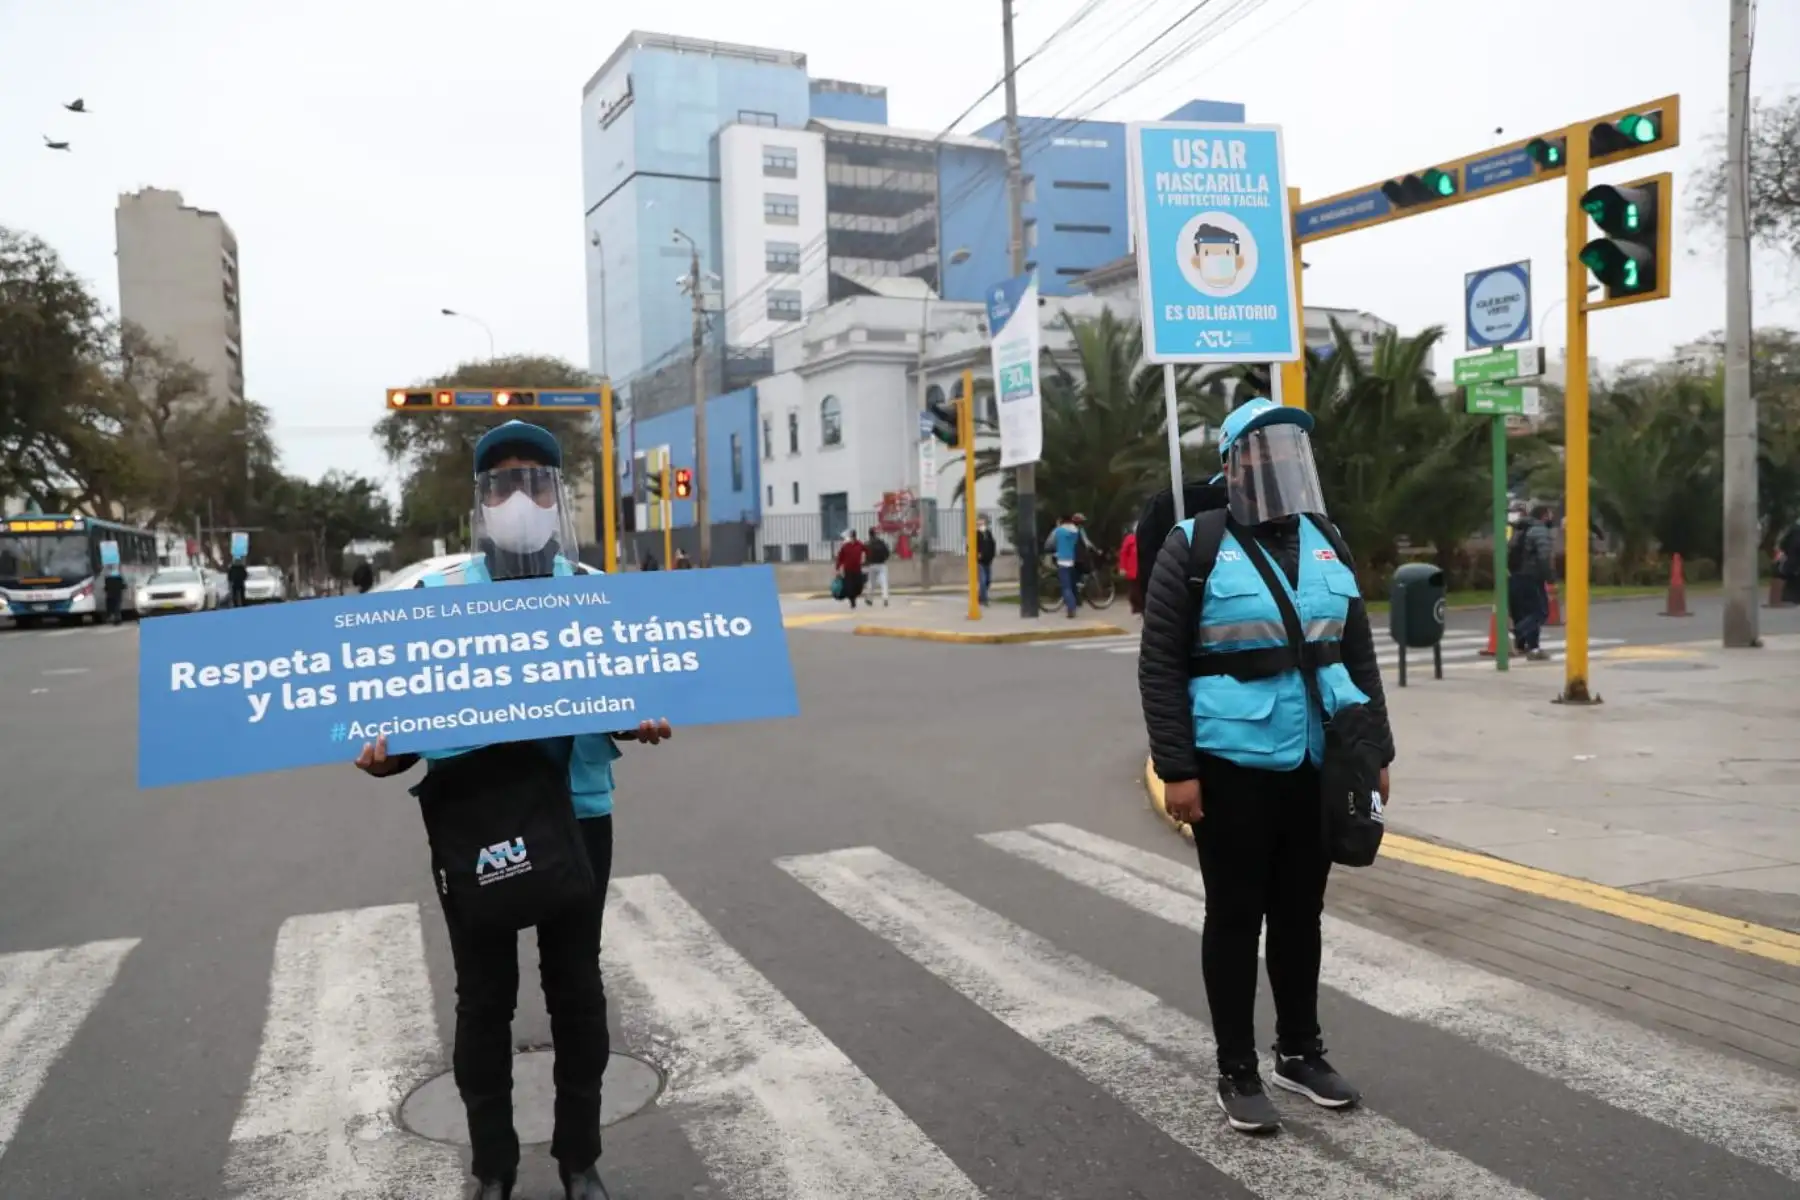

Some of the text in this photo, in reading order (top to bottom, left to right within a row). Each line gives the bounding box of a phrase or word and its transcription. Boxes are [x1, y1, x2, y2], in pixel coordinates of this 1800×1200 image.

[1172, 138, 1247, 169] USAR
[1155, 172, 1270, 193] MASCARILLA
[1167, 193, 1232, 207] PROTECTOR
[1233, 194, 1271, 208] FACIAL
[1164, 304, 1278, 321] ES OBLIGATORIO
[1195, 330, 1232, 348] ATU
[333, 591, 611, 629] SEMANA DE LA EDUCACIÓN VIAL
[170, 612, 752, 692] Respeta las normas de tránsito
[246, 647, 700, 724] y las medidas sanitarias
[330, 695, 636, 743] #AccionesQueNosCuidan
[475, 836, 527, 875] ATU
